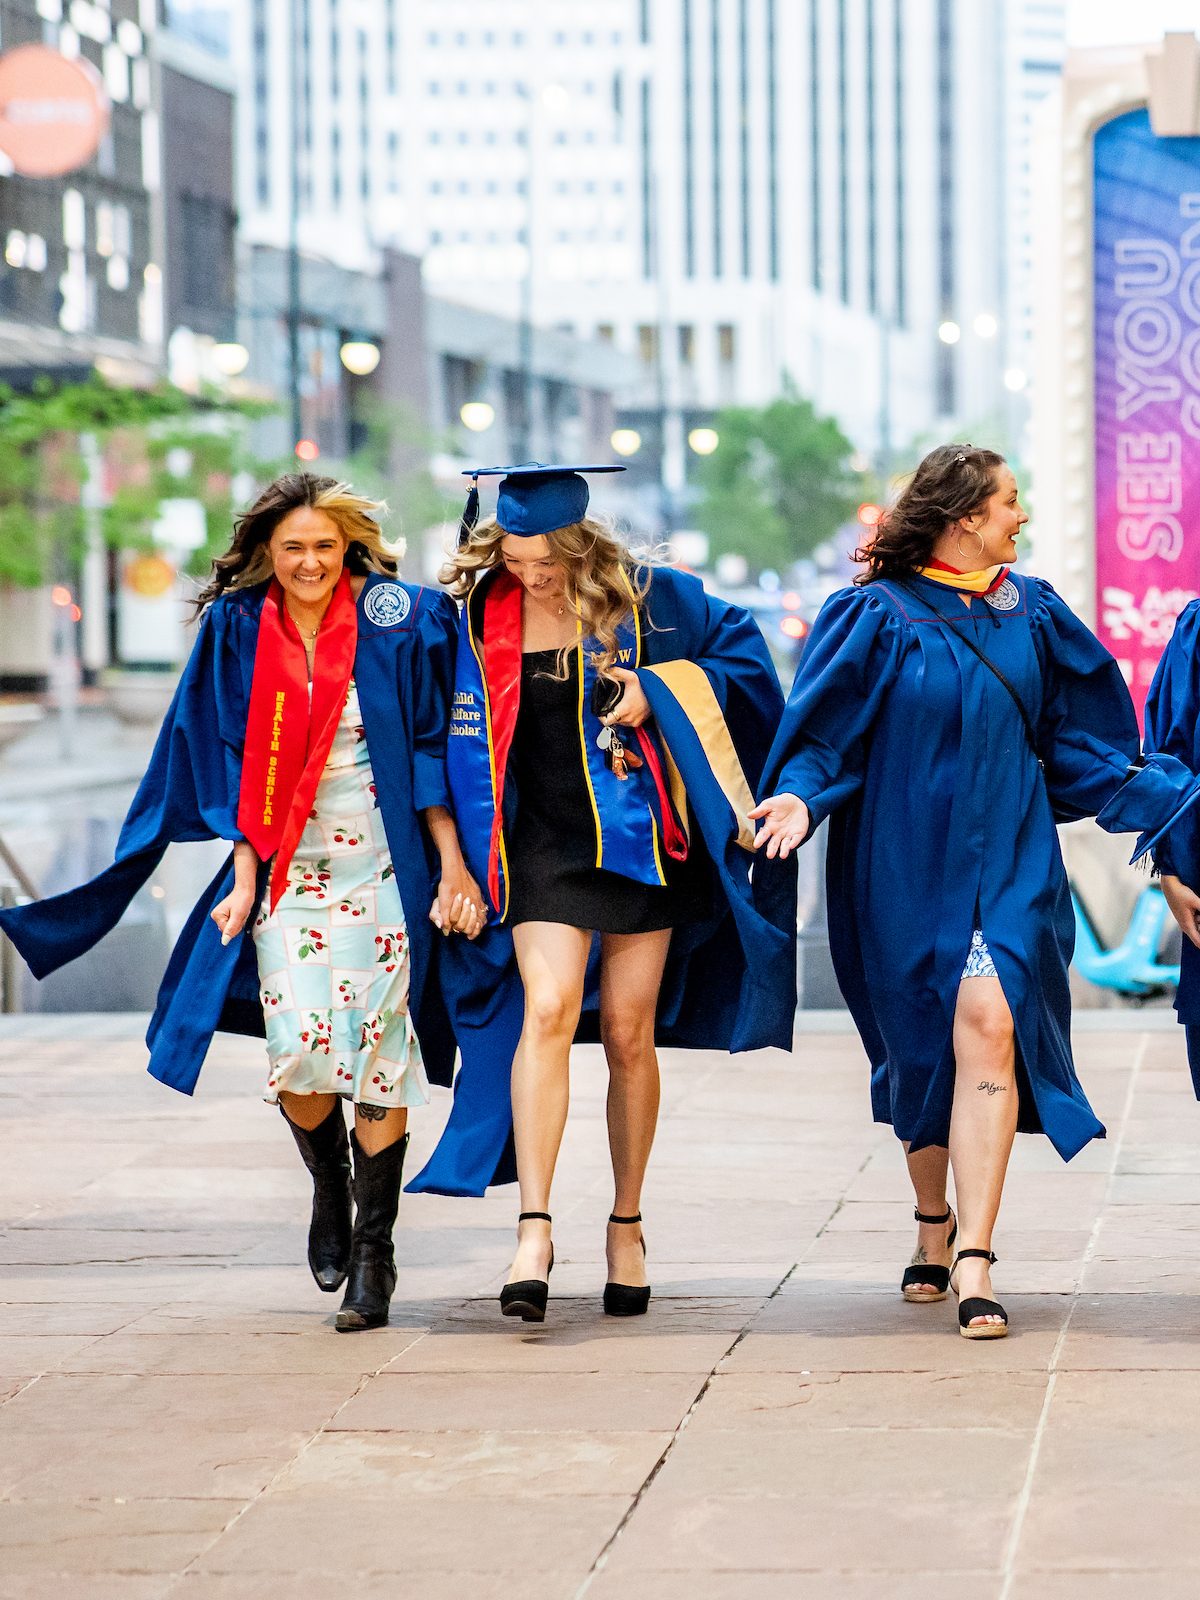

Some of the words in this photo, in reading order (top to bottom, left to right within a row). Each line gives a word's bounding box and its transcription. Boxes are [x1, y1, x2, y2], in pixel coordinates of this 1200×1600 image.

[1114, 239, 1181, 421] YOU
[1116, 431, 1184, 562] SEE
[270, 691, 285, 751] HEALTH
[263, 756, 277, 825] SCHOLAR
